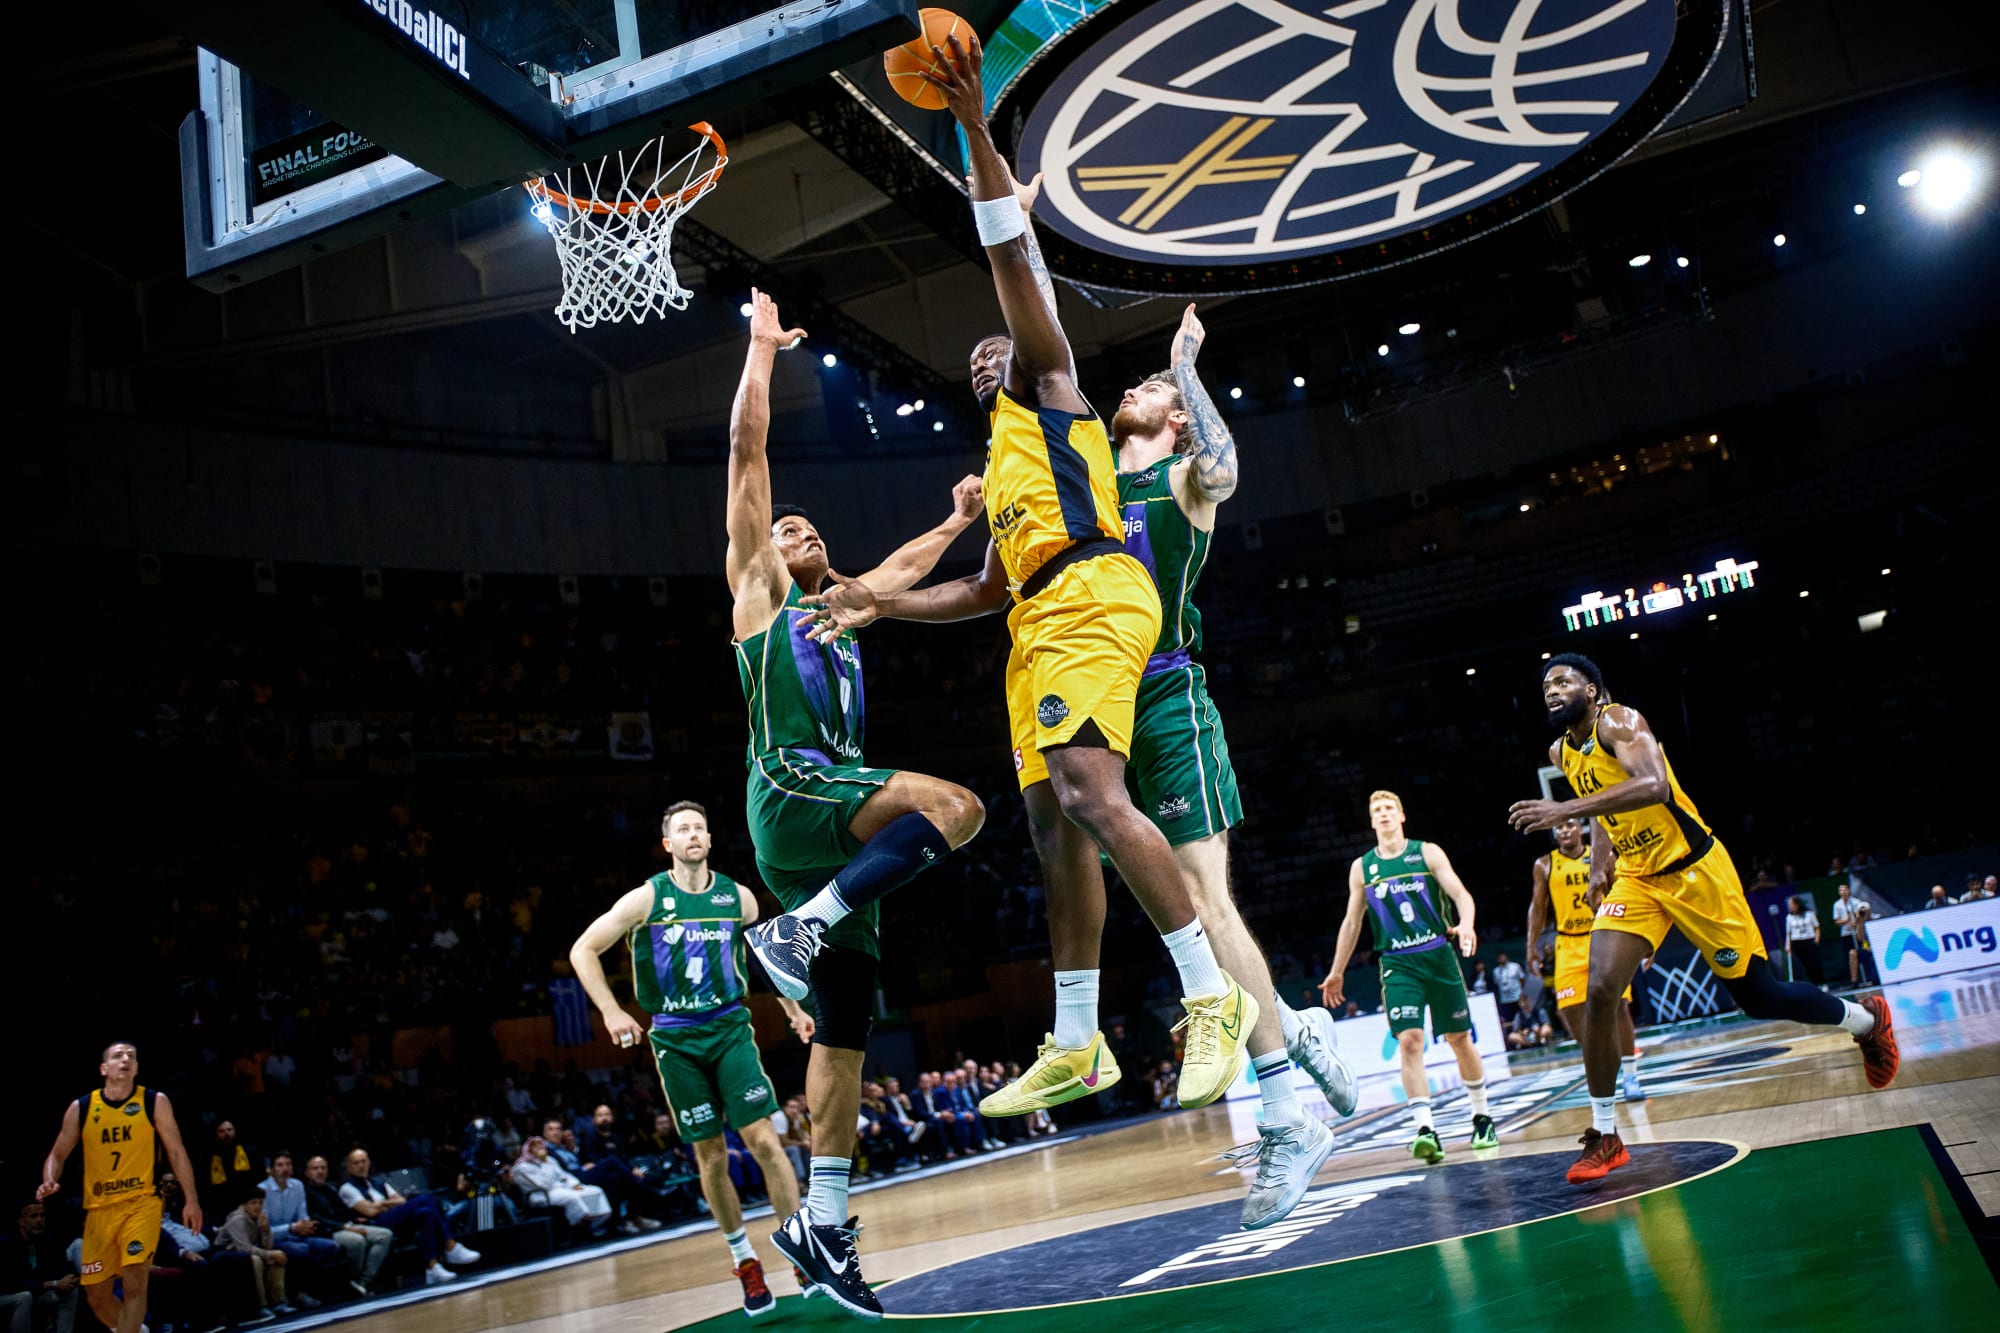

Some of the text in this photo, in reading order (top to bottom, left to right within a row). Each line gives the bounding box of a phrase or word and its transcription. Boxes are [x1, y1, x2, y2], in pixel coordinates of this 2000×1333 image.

[258, 131, 367, 181] FINAL FOU
[262, 169, 306, 188] BASKETBALL
[306, 150, 348, 172] CHAMPIONS
[841, 677, 851, 714] 0
[1577, 767, 1603, 796] AEK
[1400, 902, 1414, 923] 9
[686, 927, 732, 944] Unicaja
[1941, 926, 1998, 953] nrg
[685, 957, 703, 984] 4
[102, 1124, 132, 1144] AEK
[111, 1151, 121, 1171] 7
[105, 1177, 145, 1191] SUNEL
